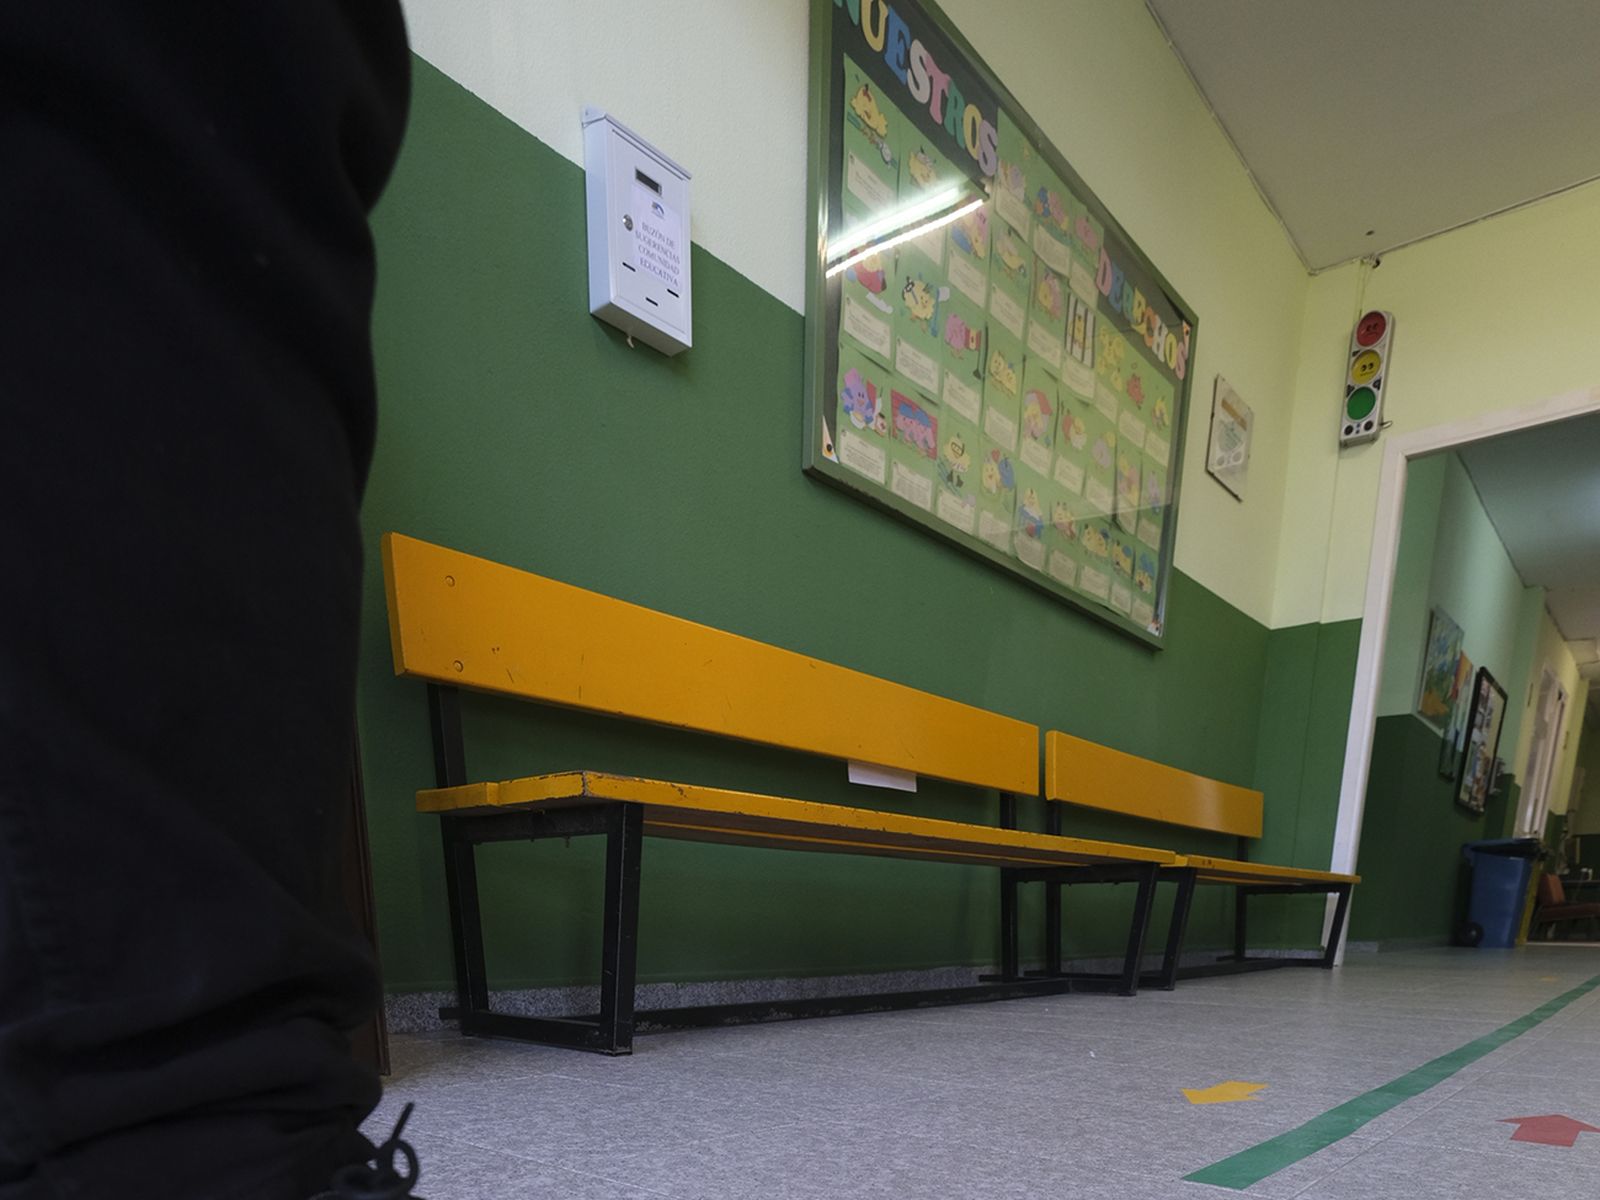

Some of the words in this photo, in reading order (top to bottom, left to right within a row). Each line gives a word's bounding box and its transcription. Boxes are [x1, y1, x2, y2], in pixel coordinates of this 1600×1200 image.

[640, 258, 679, 287] EDUCATIVA
[833, 0, 998, 177] UESTROS
[1096, 247, 1186, 380] DERECHOS
